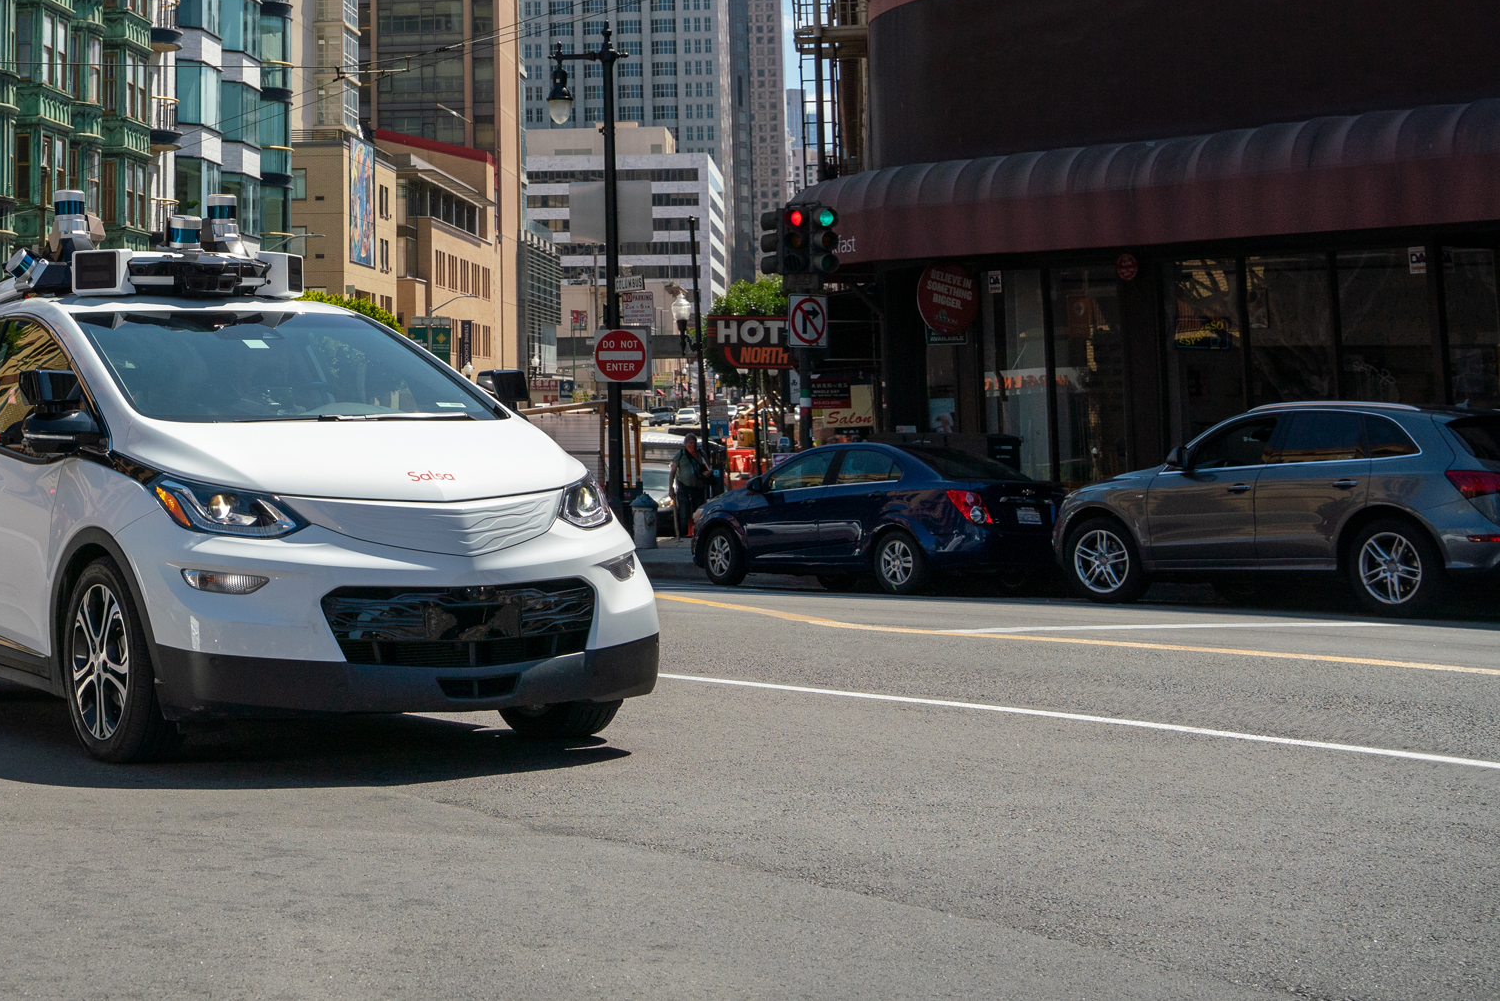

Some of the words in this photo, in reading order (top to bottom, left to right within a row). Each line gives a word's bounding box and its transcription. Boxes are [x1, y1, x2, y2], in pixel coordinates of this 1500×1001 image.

[616, 277, 642, 290] COLUMBUS
[930, 269, 961, 287] BELIEVE
[963, 278, 972, 289] IN
[927, 279, 973, 301] SOMETHING
[623, 293, 632, 302] NO
[933, 293, 963, 310] BIGGER.
[602, 340, 615, 349] DO
[621, 340, 638, 349] NOT
[606, 363, 635, 371] ENTER
[827, 411, 872, 424] Salon
[407, 470, 456, 482] Salsa
